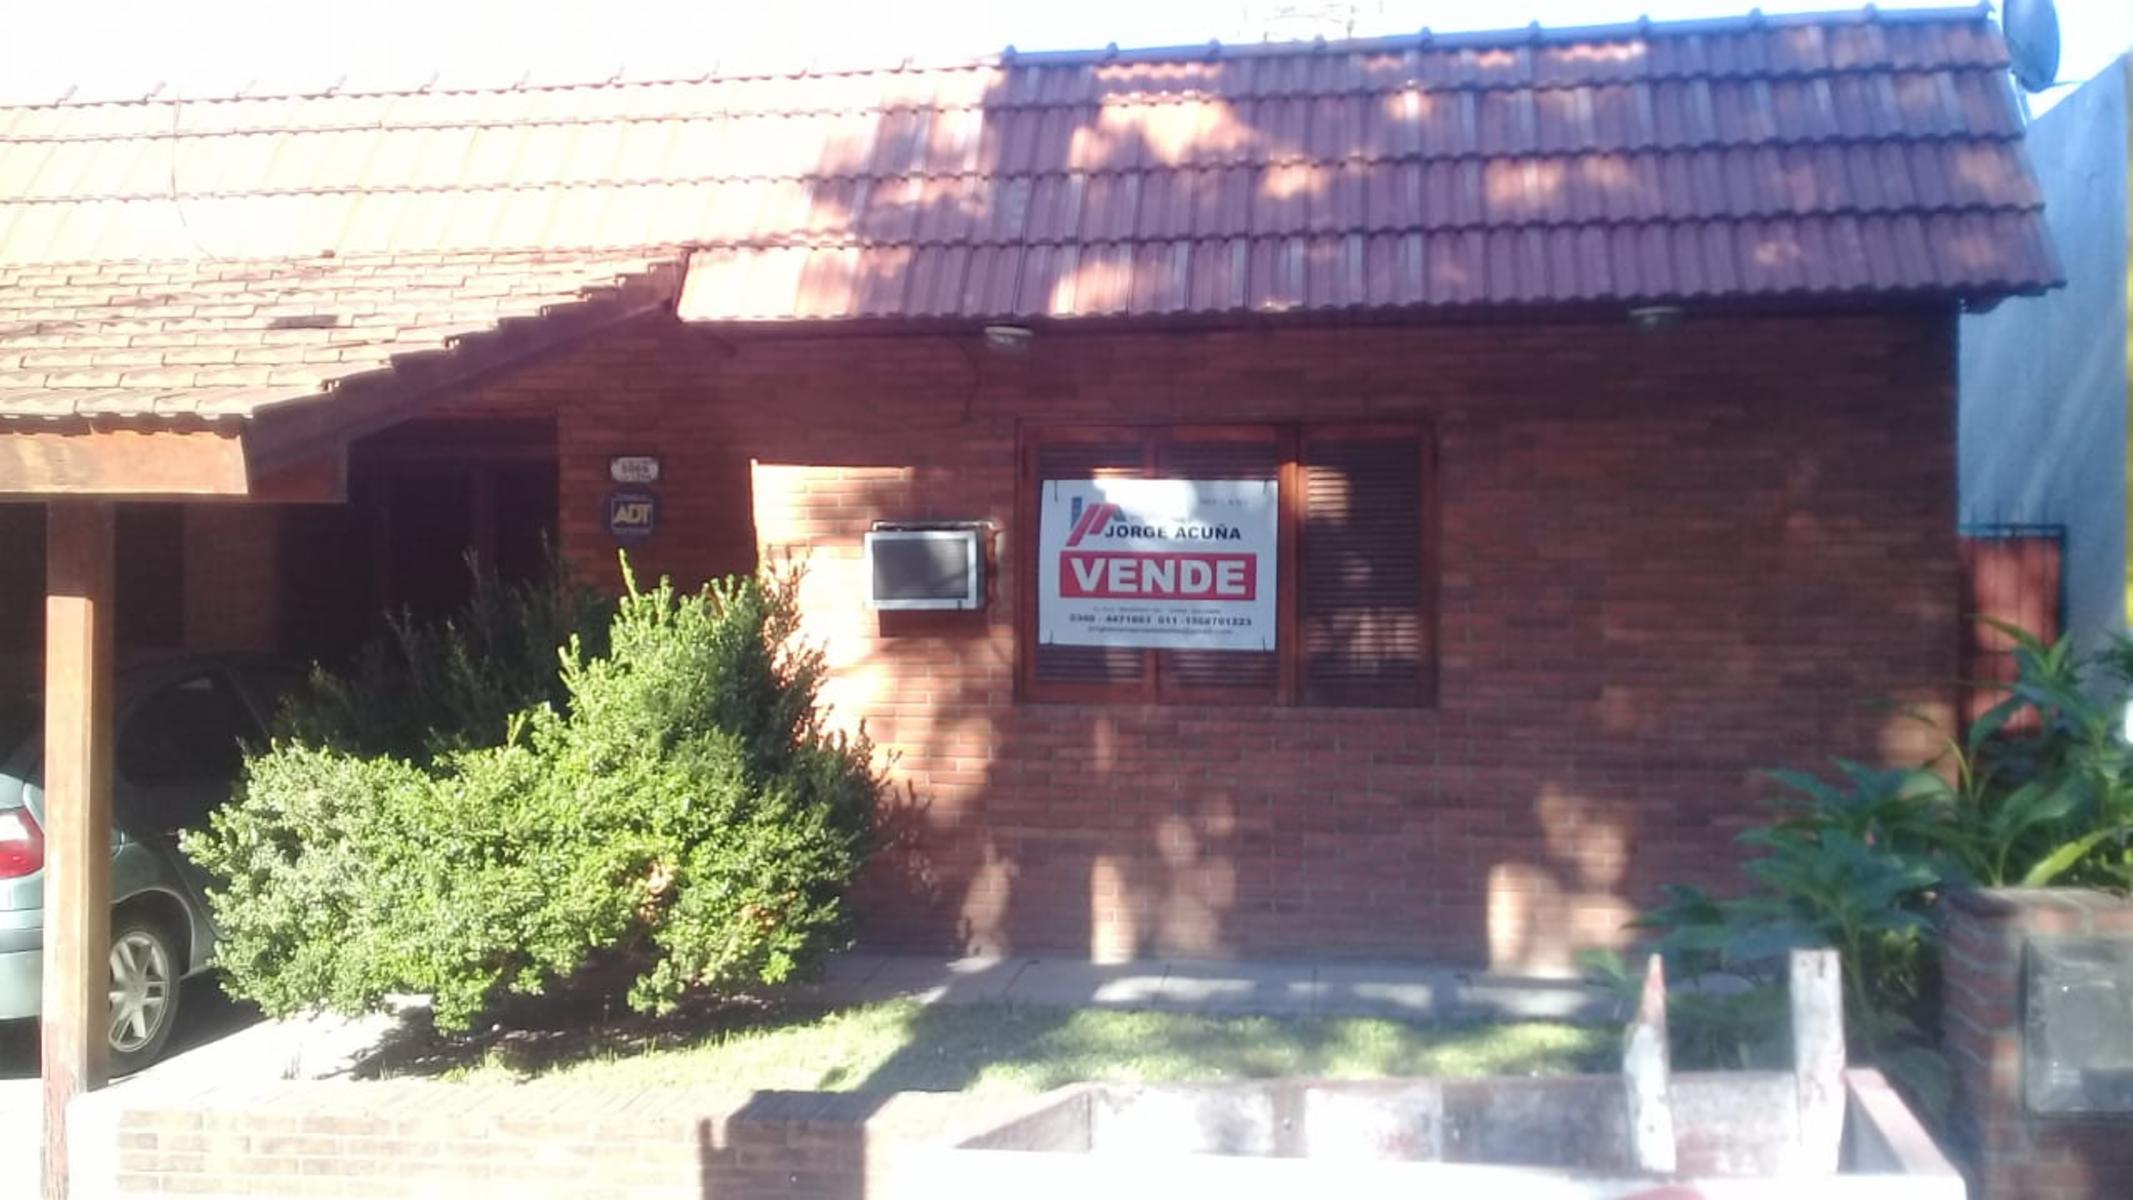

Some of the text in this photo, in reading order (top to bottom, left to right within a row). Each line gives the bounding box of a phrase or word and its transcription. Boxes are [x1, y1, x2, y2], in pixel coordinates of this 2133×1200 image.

[612, 503, 652, 524] ADT
[1105, 523, 1242, 541] JORGE ACUÑA
[1070, 557, 1247, 595] VENDE
